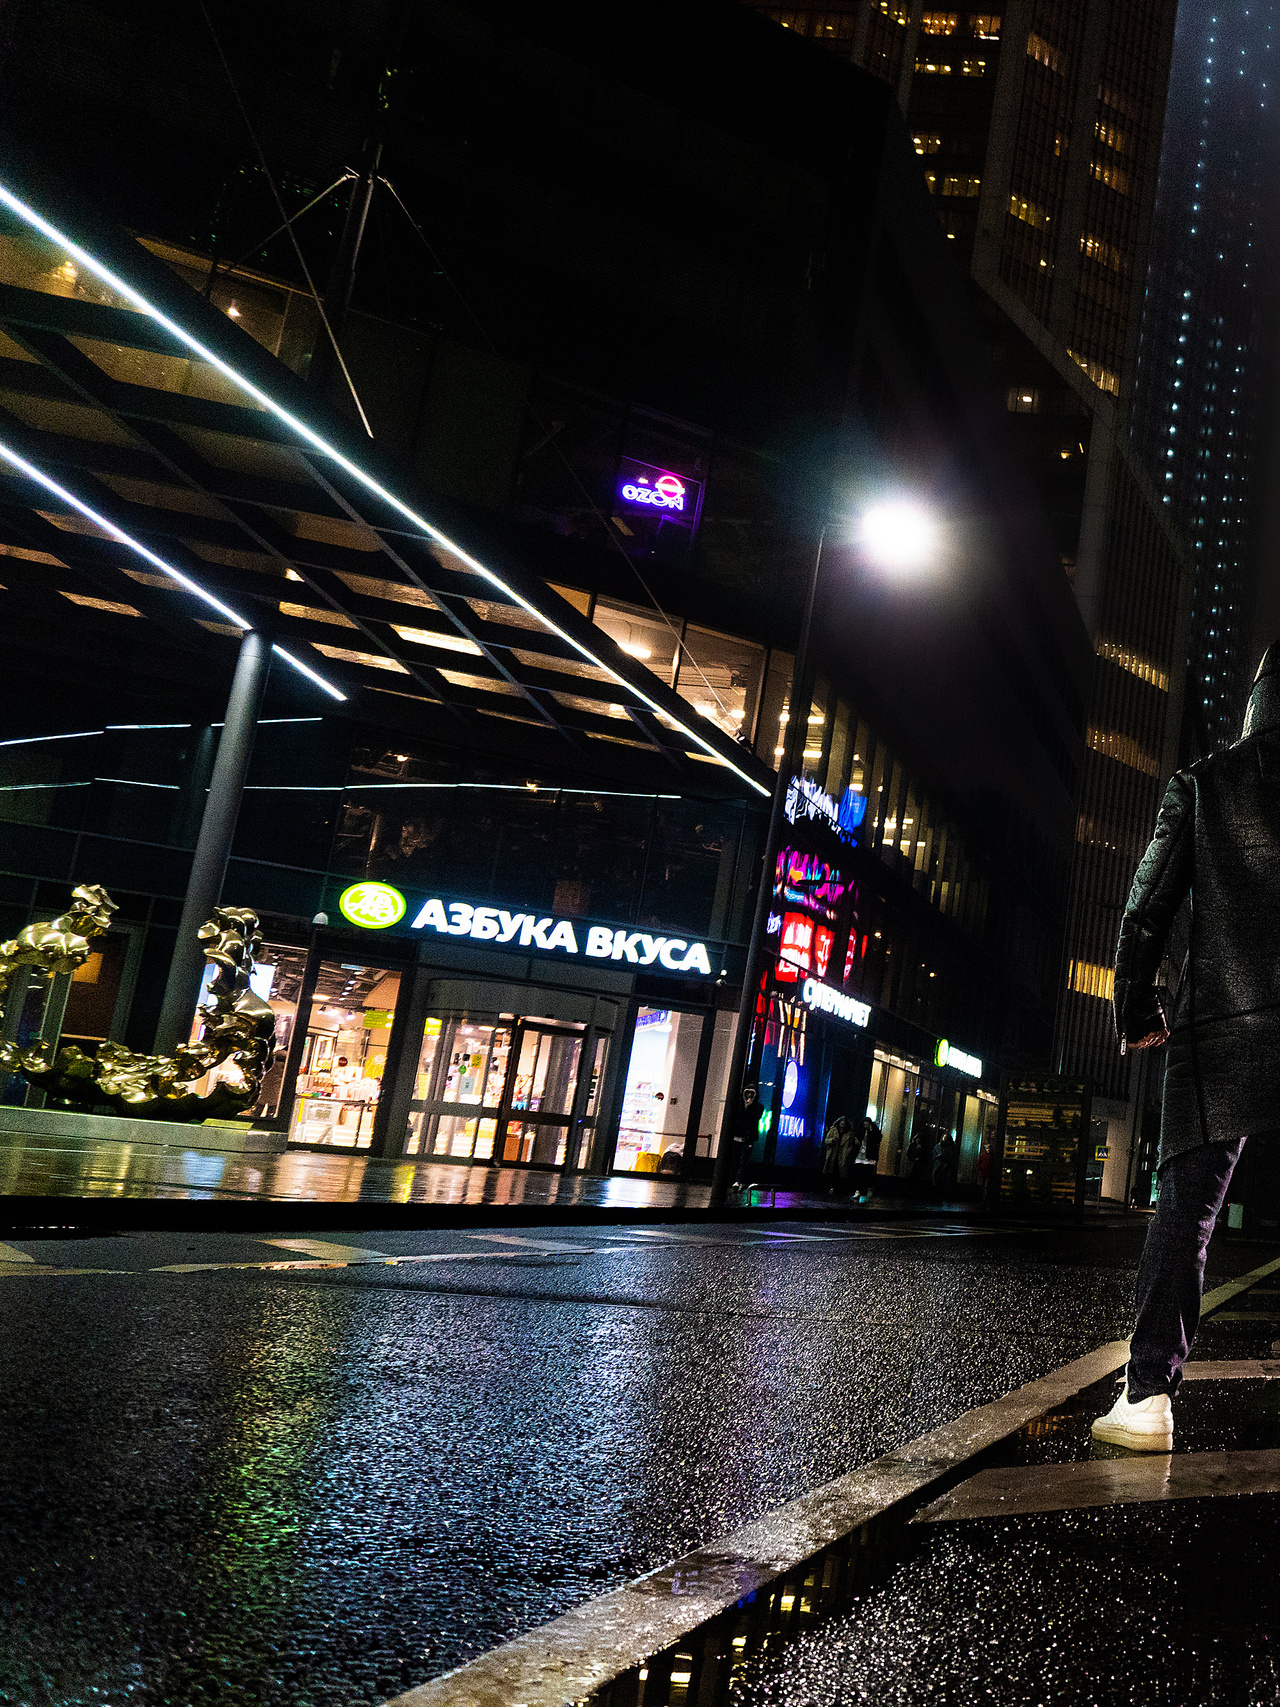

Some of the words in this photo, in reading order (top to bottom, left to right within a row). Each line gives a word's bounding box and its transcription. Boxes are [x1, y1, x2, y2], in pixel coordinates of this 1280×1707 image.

[622, 484, 684, 511] OZON
[410, 898, 579, 954] АЗБУКА
[584, 925, 712, 975] ВКУСА
